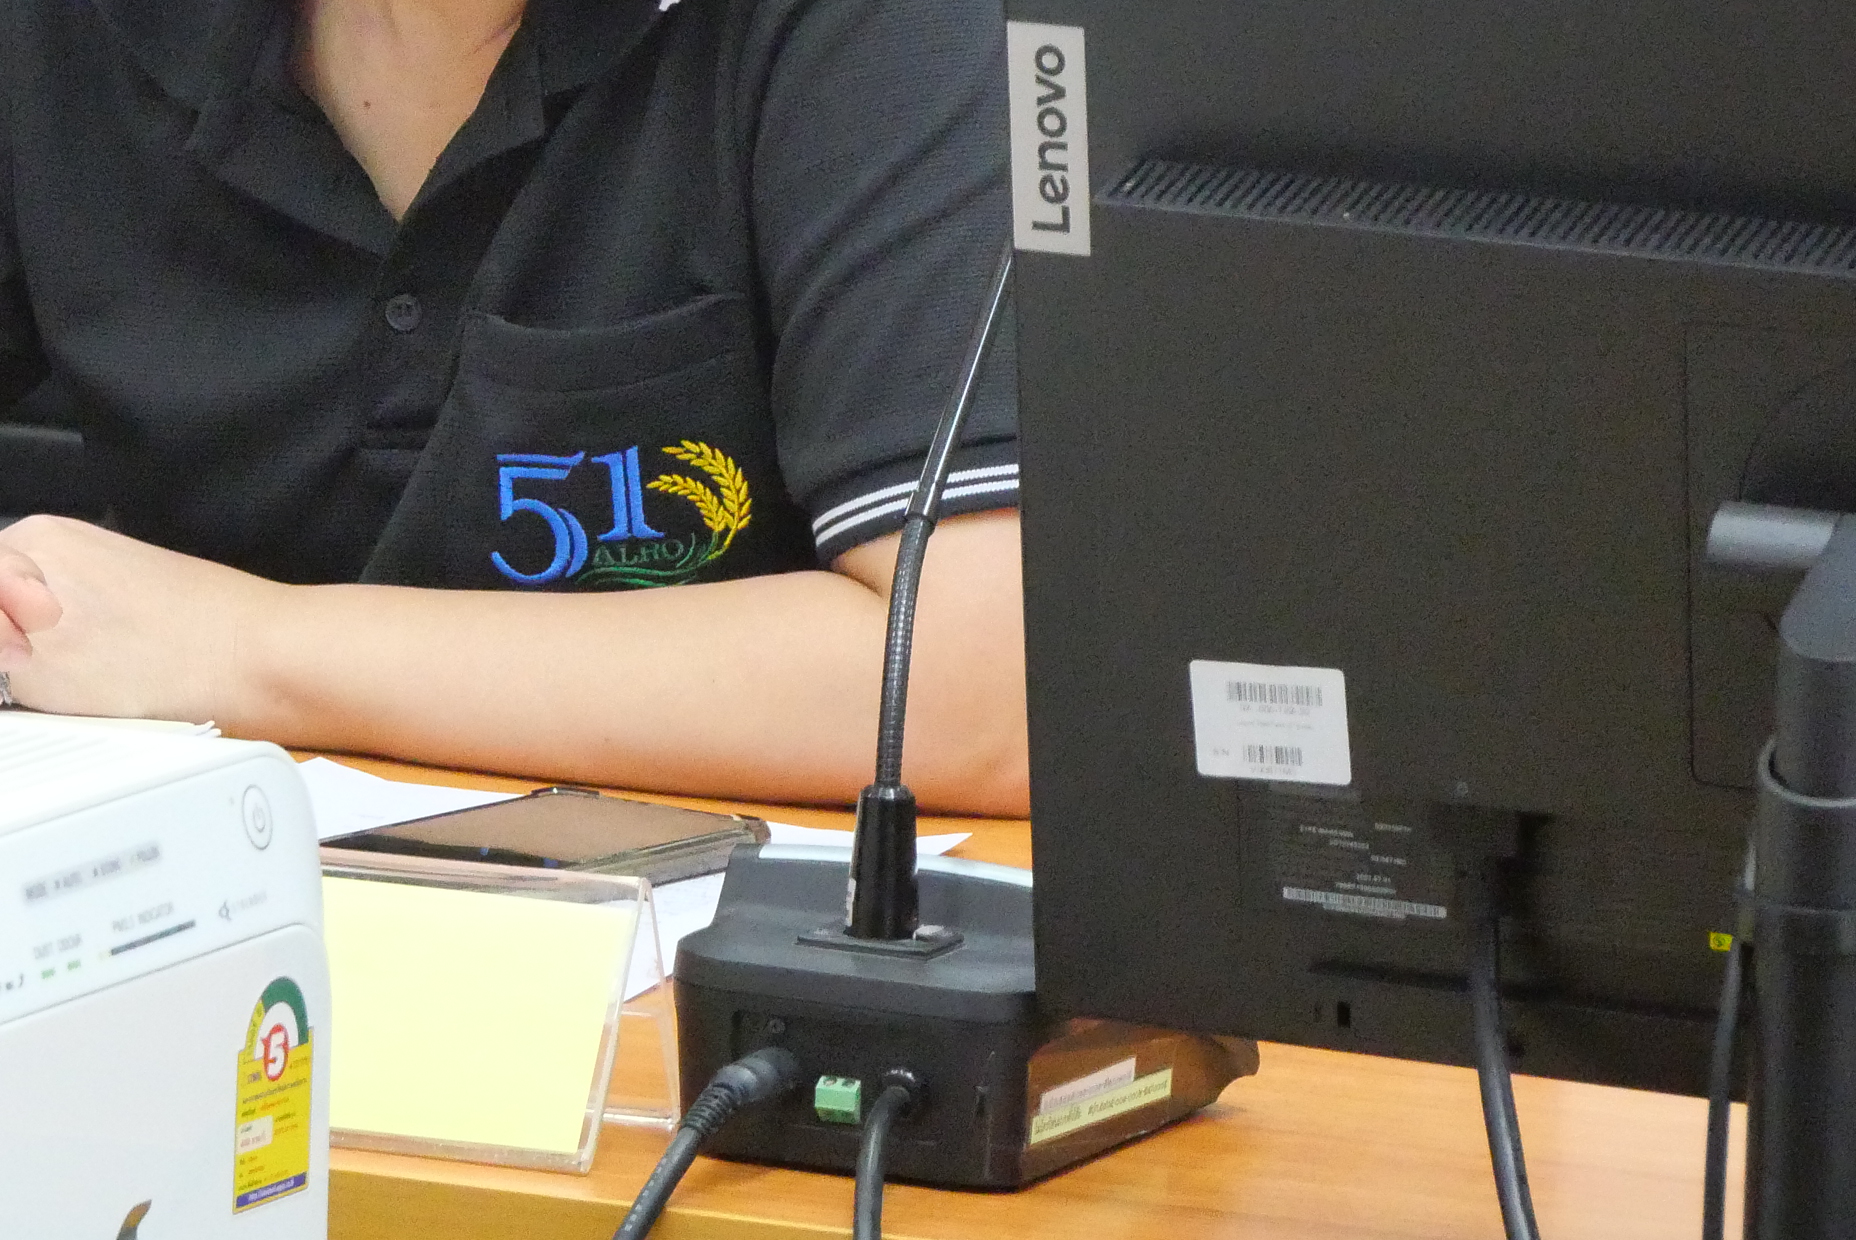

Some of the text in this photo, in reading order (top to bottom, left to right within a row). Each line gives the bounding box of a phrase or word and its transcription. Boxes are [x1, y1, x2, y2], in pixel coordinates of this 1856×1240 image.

[1032, 43, 1071, 234] Lenovo
[491, 445, 666, 586] 51
[594, 538, 685, 566] ALRO
[265, 1027, 288, 1080] 5
